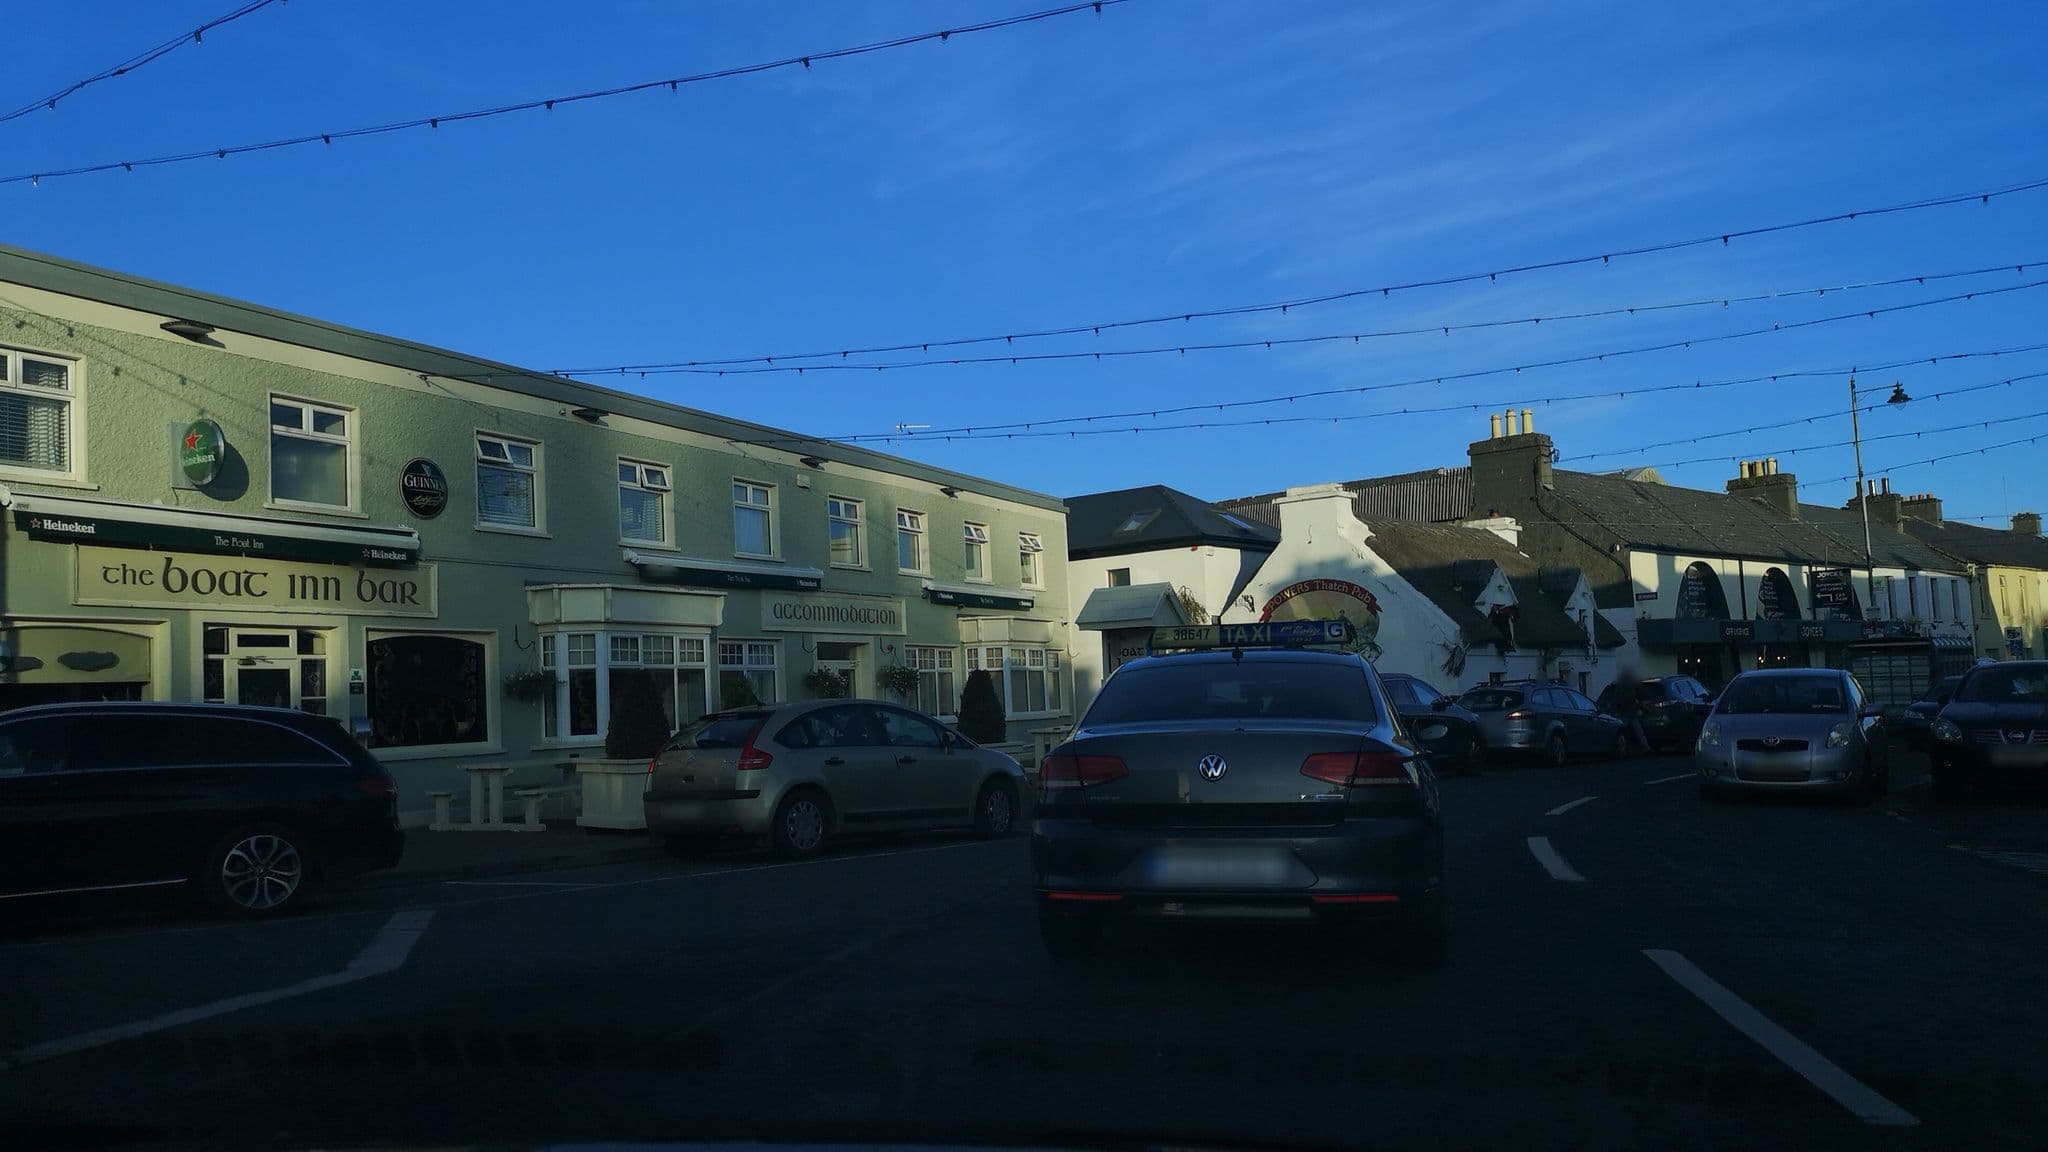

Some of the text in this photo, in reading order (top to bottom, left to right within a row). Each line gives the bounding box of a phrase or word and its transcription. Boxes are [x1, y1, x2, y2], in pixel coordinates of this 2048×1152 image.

[42, 519, 96, 534] Heineken
[214, 535, 229, 546] The
[371, 550, 407, 561] Heineken
[102, 557, 421, 605] the boat inn bar
[1268, 580, 1372, 610] POWERS Thatch Pub
[773, 602, 896, 625] accommodation
[1173, 628, 1210, 641] 38647
[1225, 625, 1272, 643] TAXI
